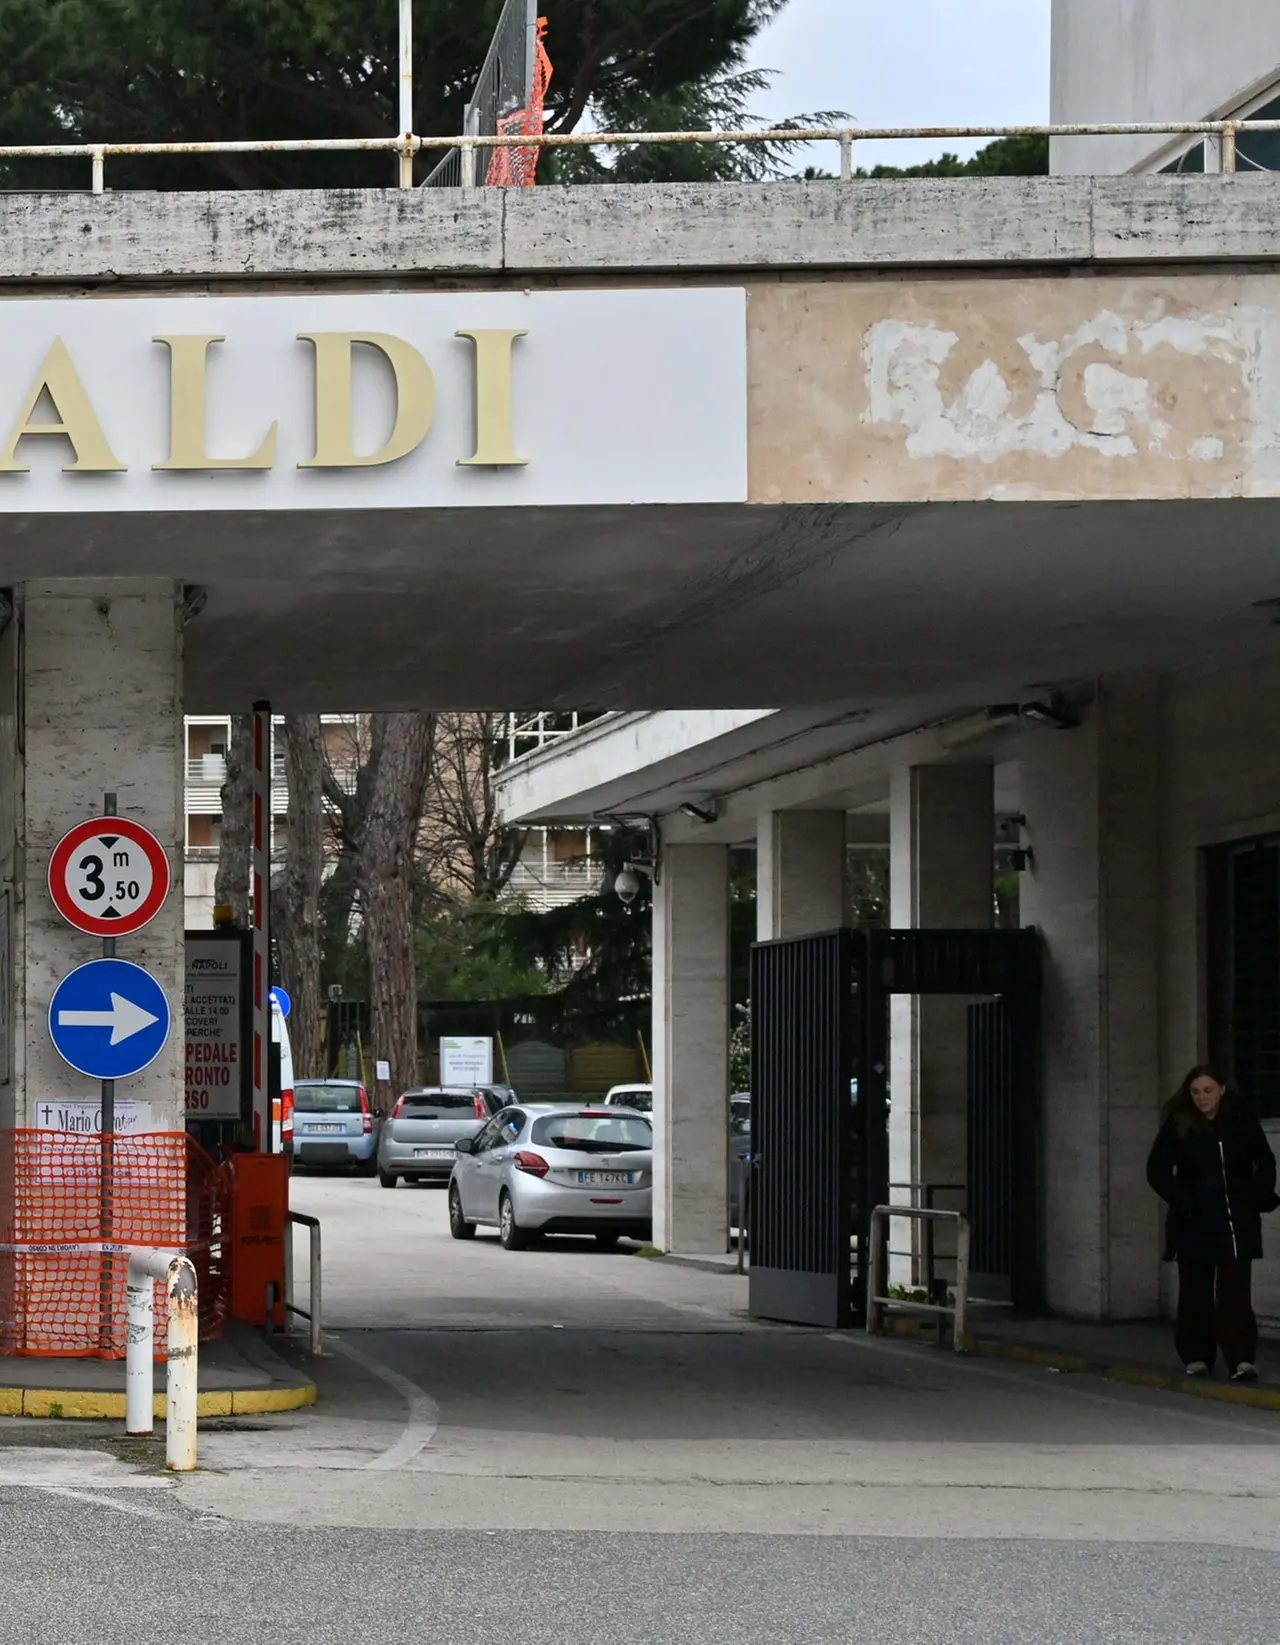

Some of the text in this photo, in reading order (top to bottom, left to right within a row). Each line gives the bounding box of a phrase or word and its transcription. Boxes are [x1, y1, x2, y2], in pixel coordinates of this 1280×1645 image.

[186, 1017, 218, 1026] COVERI
[185, 1042, 237, 1063] PEDALE
[185, 1066, 230, 1086] RONTO
[185, 1090, 209, 1109] RSO
[58, 1110, 91, 1132] Mario
